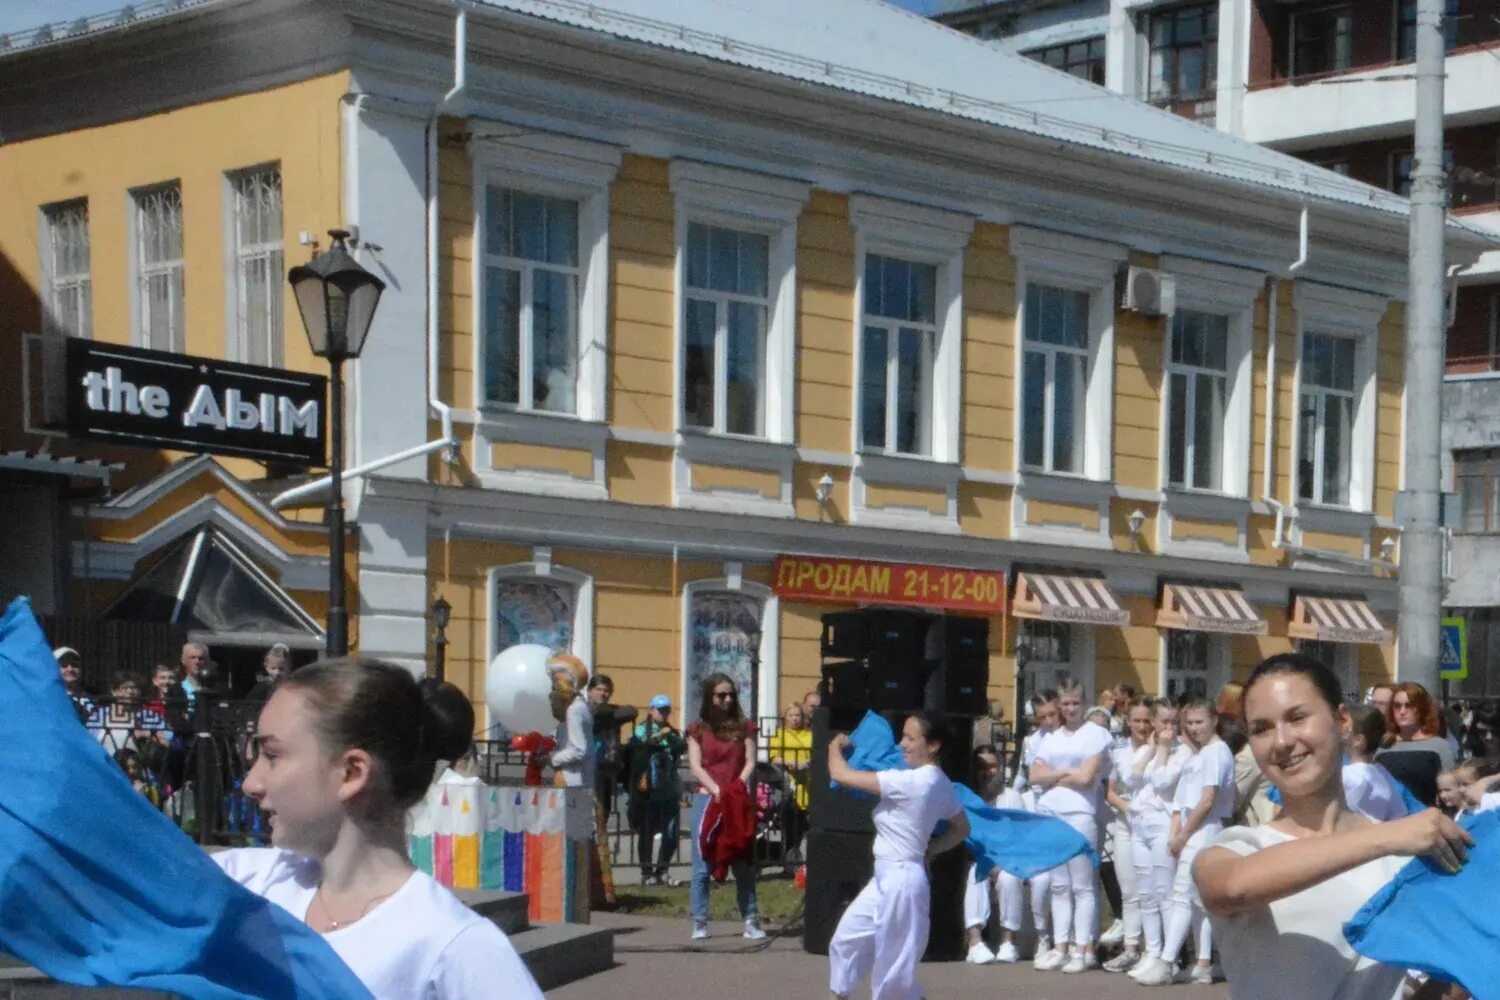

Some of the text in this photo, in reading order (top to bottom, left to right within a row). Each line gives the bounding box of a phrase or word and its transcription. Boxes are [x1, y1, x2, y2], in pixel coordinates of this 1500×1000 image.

[82, 366, 319, 439] the ДЫМ
[777, 559, 998, 602] ПРОДАМ 21-12-00
